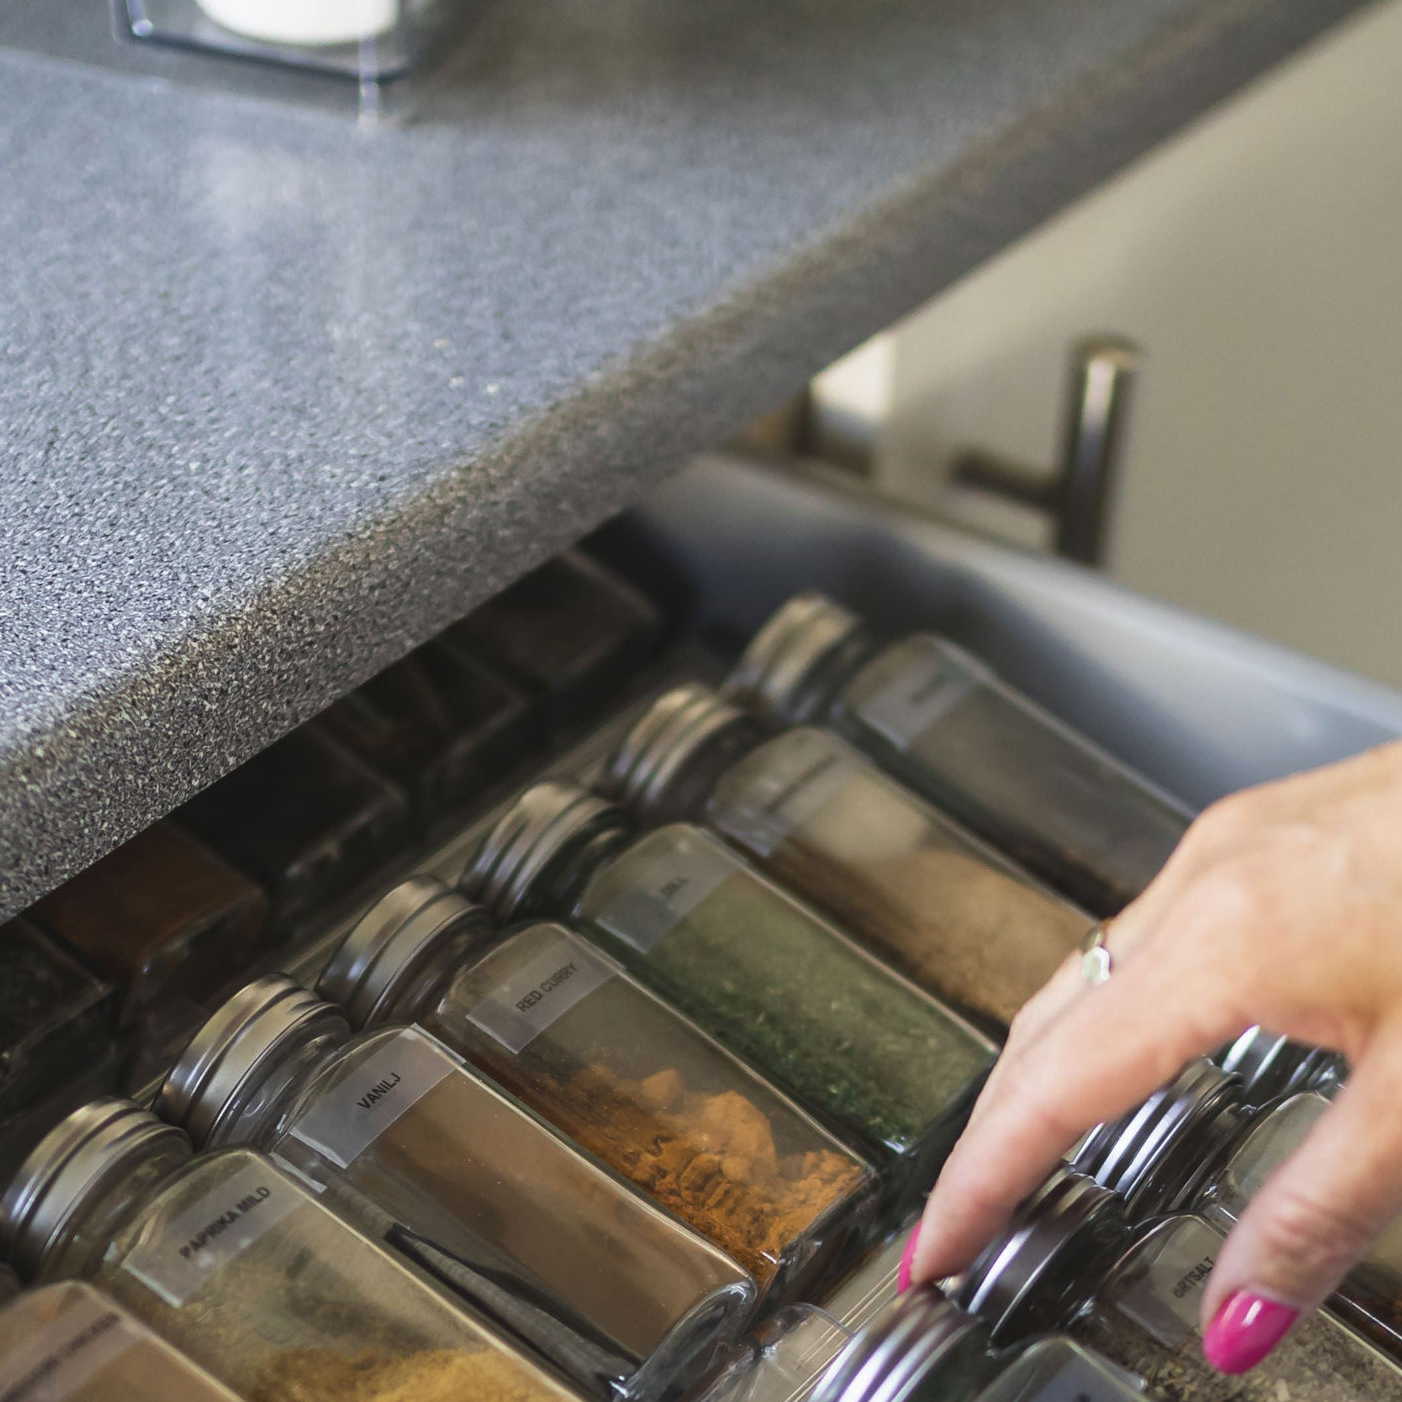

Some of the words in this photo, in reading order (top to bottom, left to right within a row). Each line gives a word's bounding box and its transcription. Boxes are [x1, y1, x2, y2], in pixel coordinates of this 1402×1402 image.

[515, 990, 543, 1012] RED
[540, 961, 578, 992] CURRY
[356, 1071, 401, 1109] VANILJ
[179, 1210, 239, 1258] PAPRIKA
[235, 1186, 271, 1213] MILD
